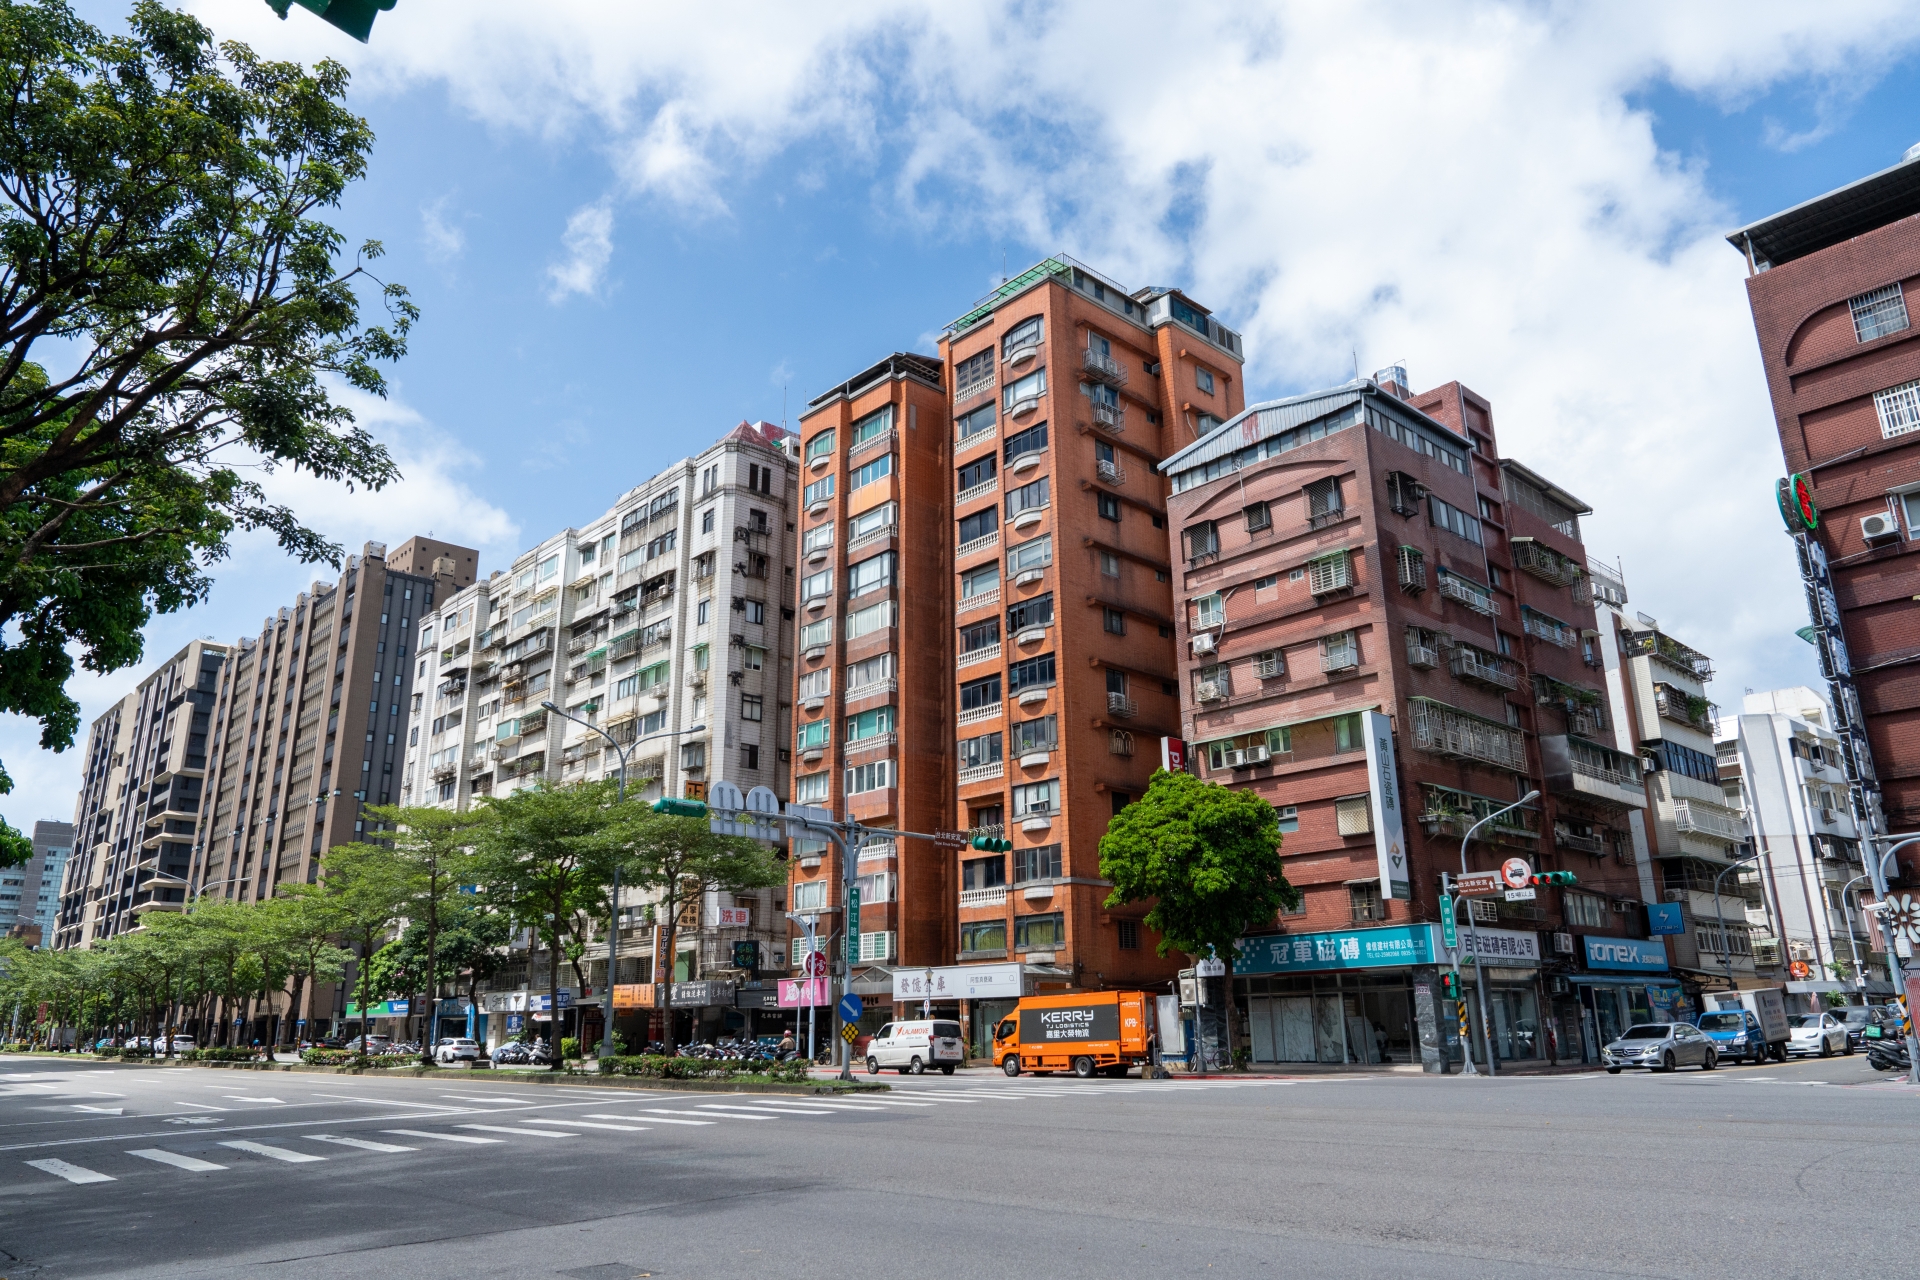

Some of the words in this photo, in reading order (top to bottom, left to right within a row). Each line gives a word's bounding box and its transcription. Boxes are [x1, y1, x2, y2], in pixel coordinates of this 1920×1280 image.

[1379, 737, 1395, 811] 黃山石瓷磚
[936, 832, 961, 841] 台北新安宮
[1459, 879, 1487, 888] 台北新安宮
[722, 909, 746, 923] 洗車
[850, 898, 858, 937] 松江路
[1443, 907, 1453, 935] 德惠街
[1270, 936, 1361, 965] 冠軍磁磚
[1464, 934, 1533, 956] 百宏磁磚有限公司
[1589, 943, 1640, 964] ionex
[901, 975, 946, 993] 發億金庫
[1041, 1010, 1094, 1024] KERRY
[902, 1027, 929, 1036] LALAMOVE
[1046, 1029, 1089, 1039] 嘉里大榮物流
